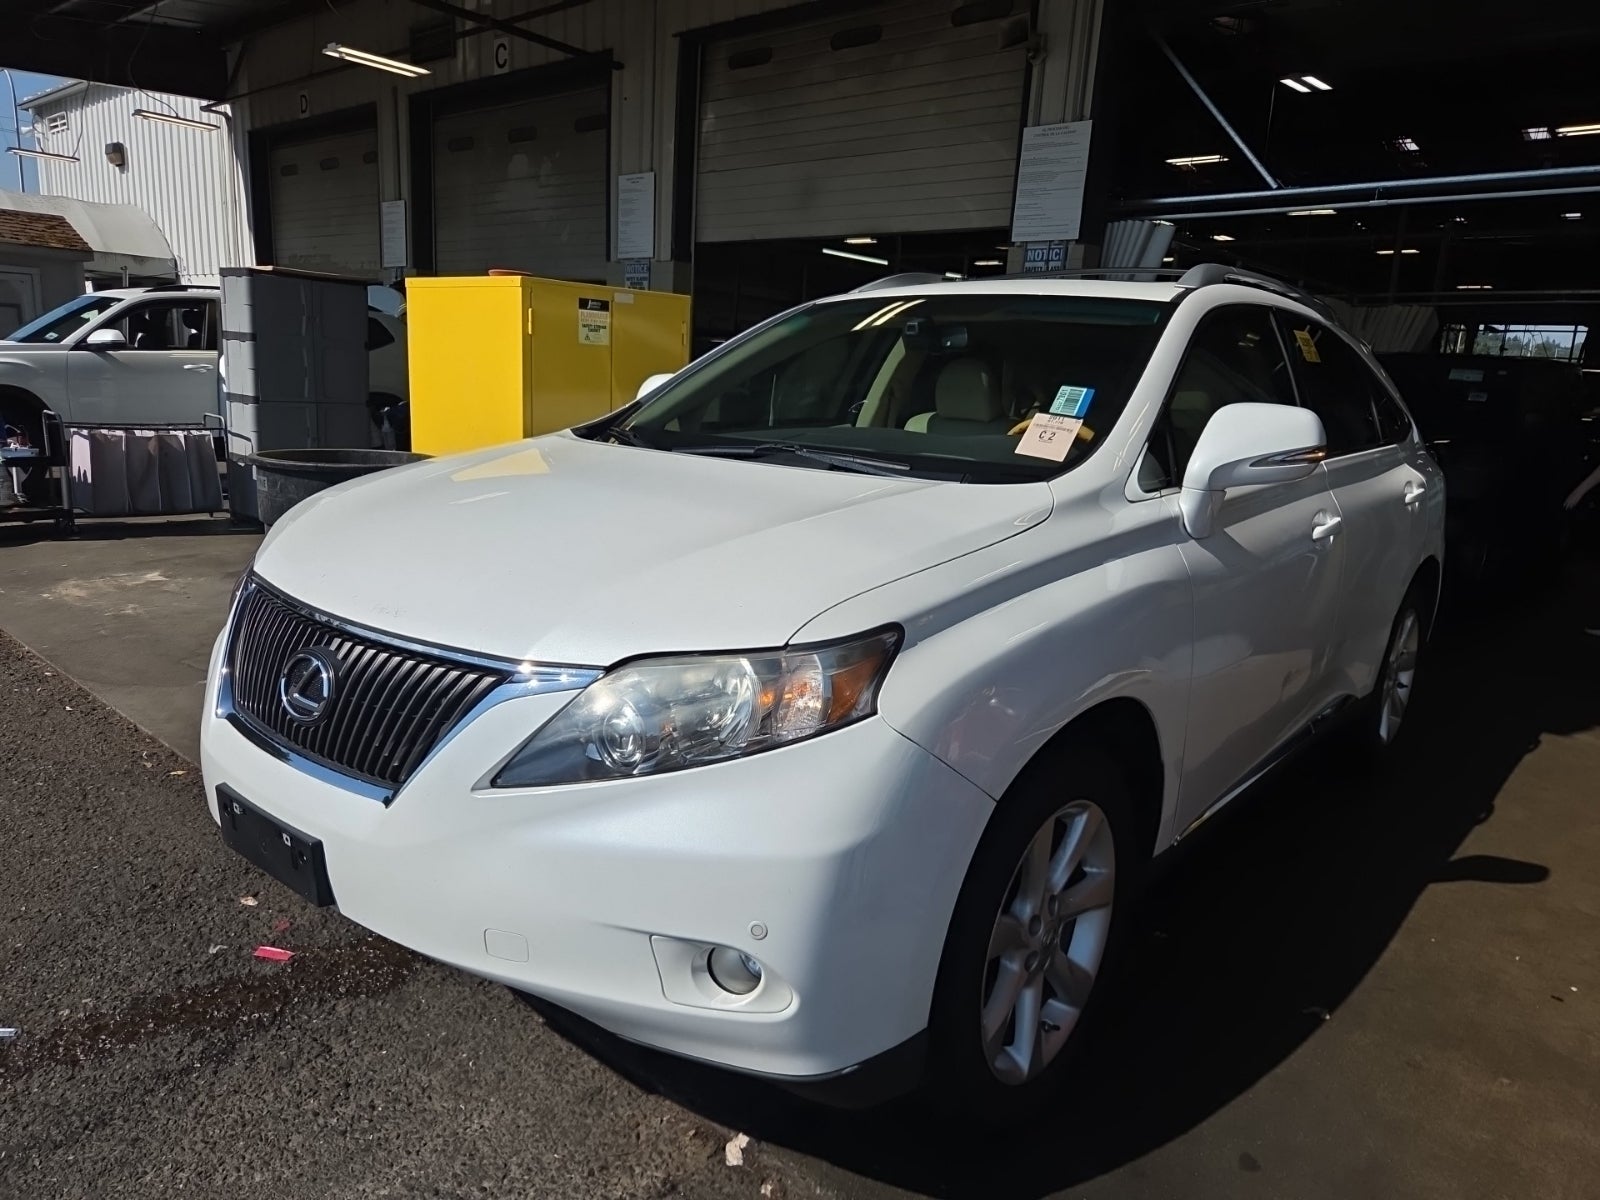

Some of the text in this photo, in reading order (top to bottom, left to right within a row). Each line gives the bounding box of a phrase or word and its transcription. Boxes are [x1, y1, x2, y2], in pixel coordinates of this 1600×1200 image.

[495, 43, 508, 69] C
[300, 94, 308, 114] D
[1027, 248, 1063, 260] NOTIC
[1038, 430, 1056, 440] C 2
